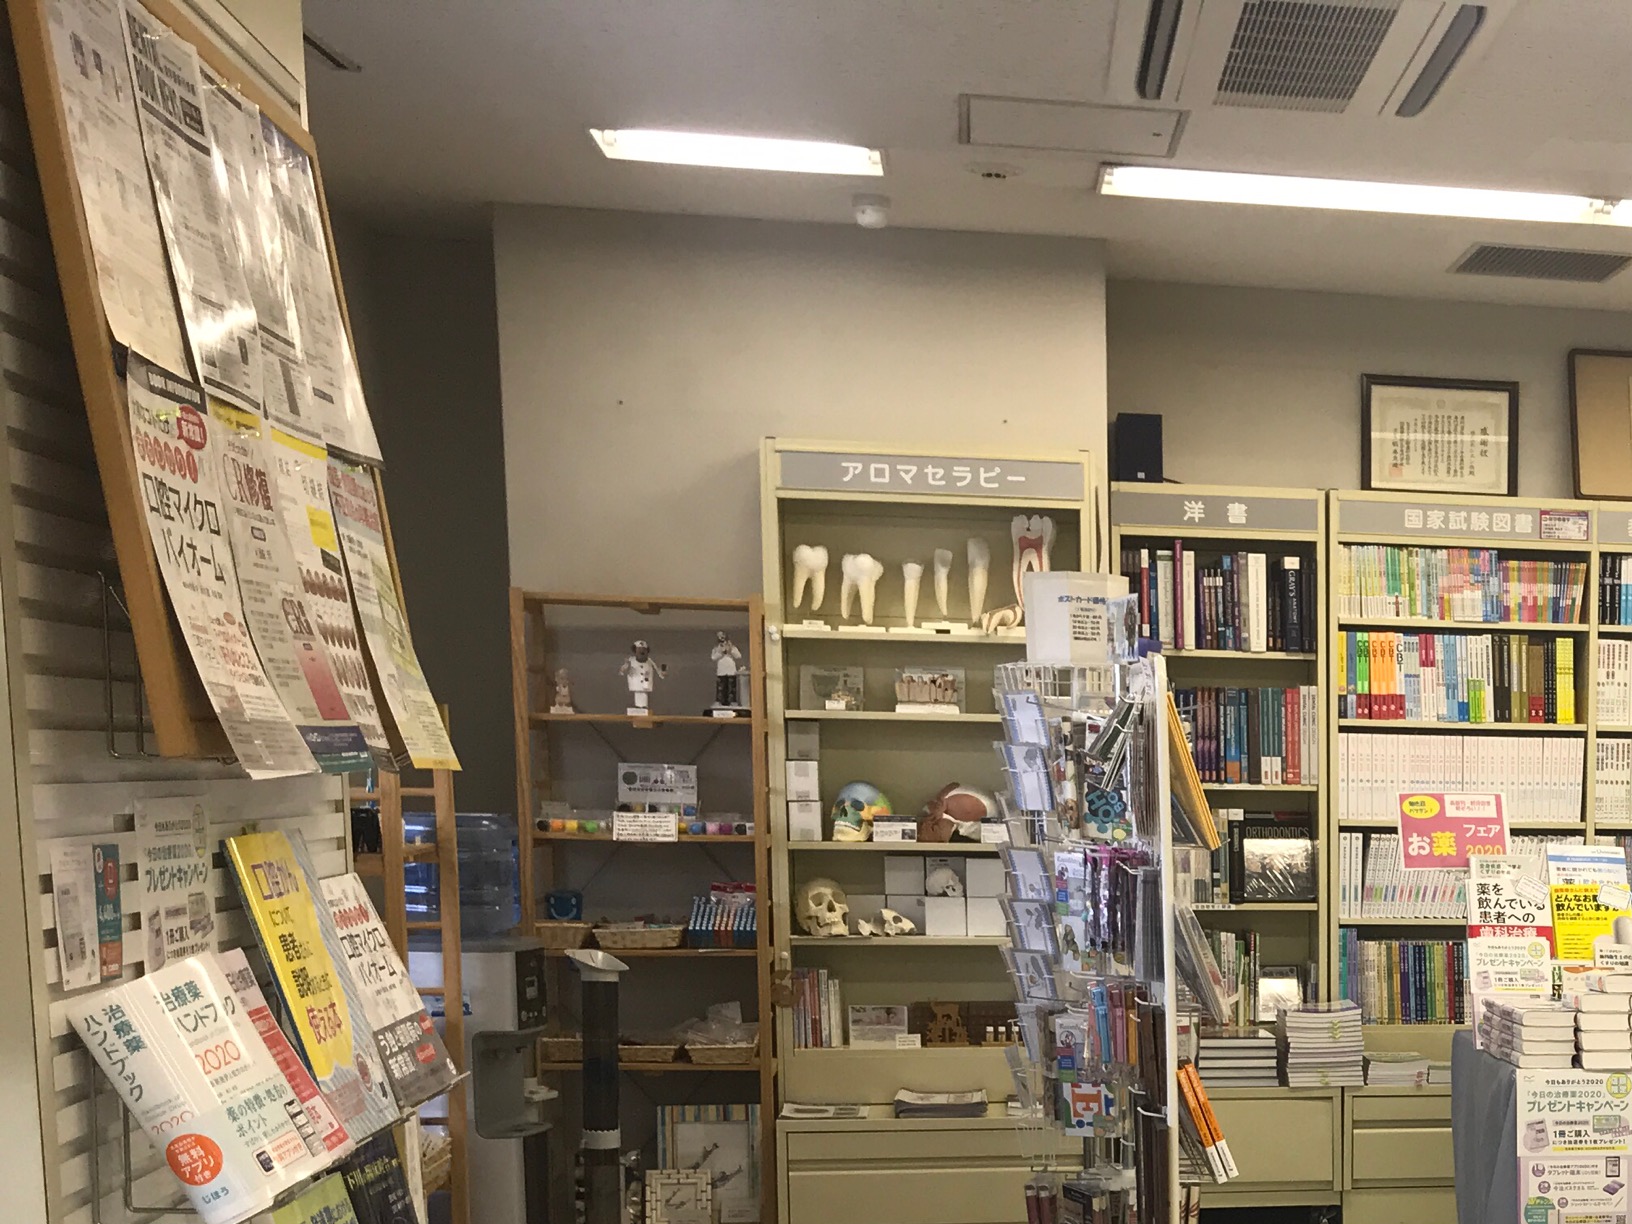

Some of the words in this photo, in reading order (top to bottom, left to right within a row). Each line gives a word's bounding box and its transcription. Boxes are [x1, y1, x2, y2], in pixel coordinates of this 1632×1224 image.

[841, 462, 1026, 487] アロマセラピー
[1404, 509, 1533, 533] 国家試験図書
[1288, 570, 1296, 597] GRAY'S
[1408, 831, 1457, 857] お薬
[1463, 824, 1501, 838] フェア
[1476, 883, 1503, 896] 薬を
[1477, 898, 1545, 910] 飲んでいる
[1479, 911, 1535, 924] 患者への
[102, 1004, 148, 1055] 治療薬
[84, 1015, 143, 1103] ハンドブック
[196, 1040, 241, 1075] 2020
[1527, 1101, 1630, 1113] プレゼントキャンペーン
[1552, 1130, 1590, 1138] 1冊ご購入
[178, 1146, 204, 1166] 無料
[181, 1157, 214, 1177] アプリ
[202, 1186, 229, 1203] じほう
